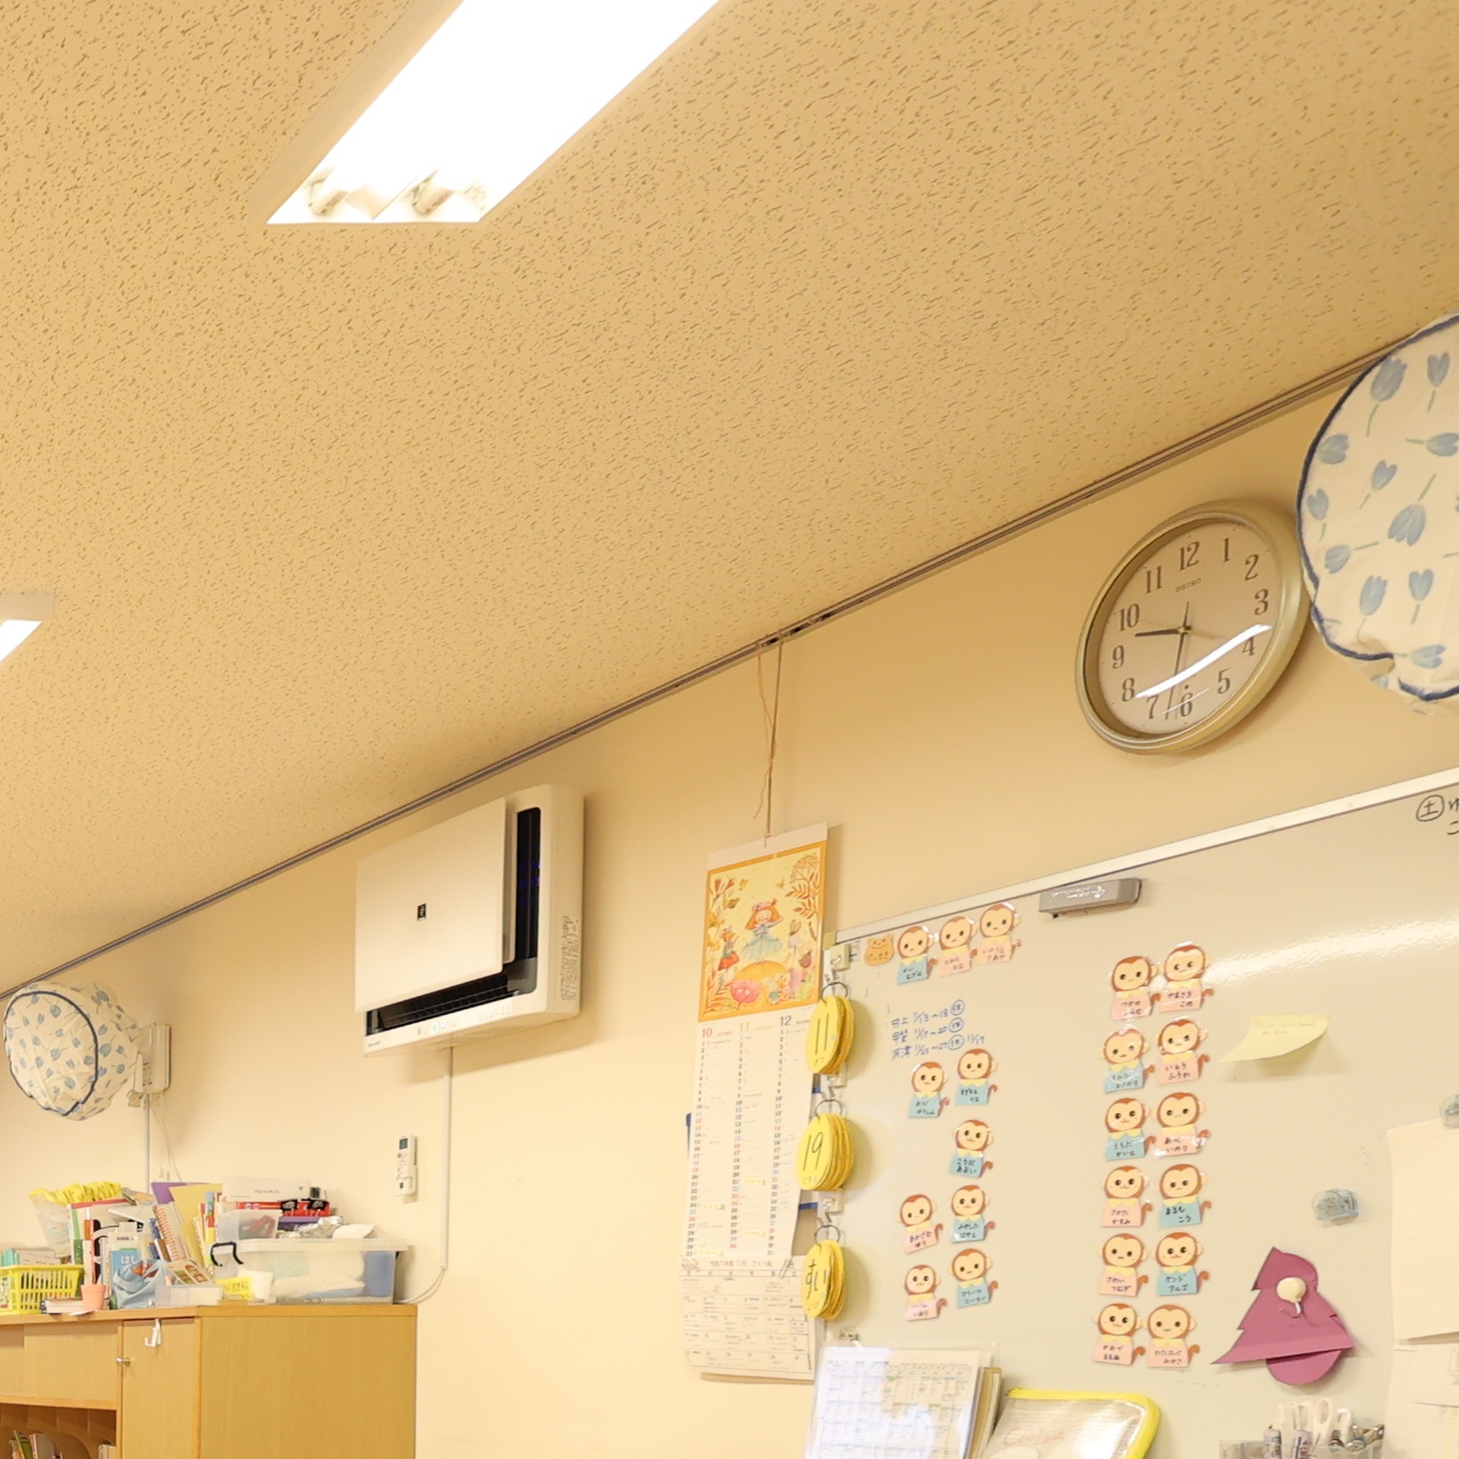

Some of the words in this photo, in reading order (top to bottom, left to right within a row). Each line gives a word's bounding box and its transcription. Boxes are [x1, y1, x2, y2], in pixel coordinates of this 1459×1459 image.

[1179, 541, 1200, 571] 12
[1222, 538, 1231, 562] 1
[1144, 566, 1163, 593] 11
[1244, 554, 1259, 581] 2
[1254, 589, 1269, 615] 3
[1117, 603, 1140, 631] 10
[1112, 645, 1124, 669] 9
[1242, 632, 1256, 657] 4
[1122, 678, 1135, 702] 8
[1217, 668, 1231, 694] 5
[1146, 695, 1159, 720] 7
[1180, 690, 1193, 717] 6
[702, 1028, 712, 1037] 10
[780, 1015, 792, 1026] 12
[815, 1013, 830, 1055] 11
[803, 1131, 824, 1172] 19
[805, 1259, 827, 1300] すい
